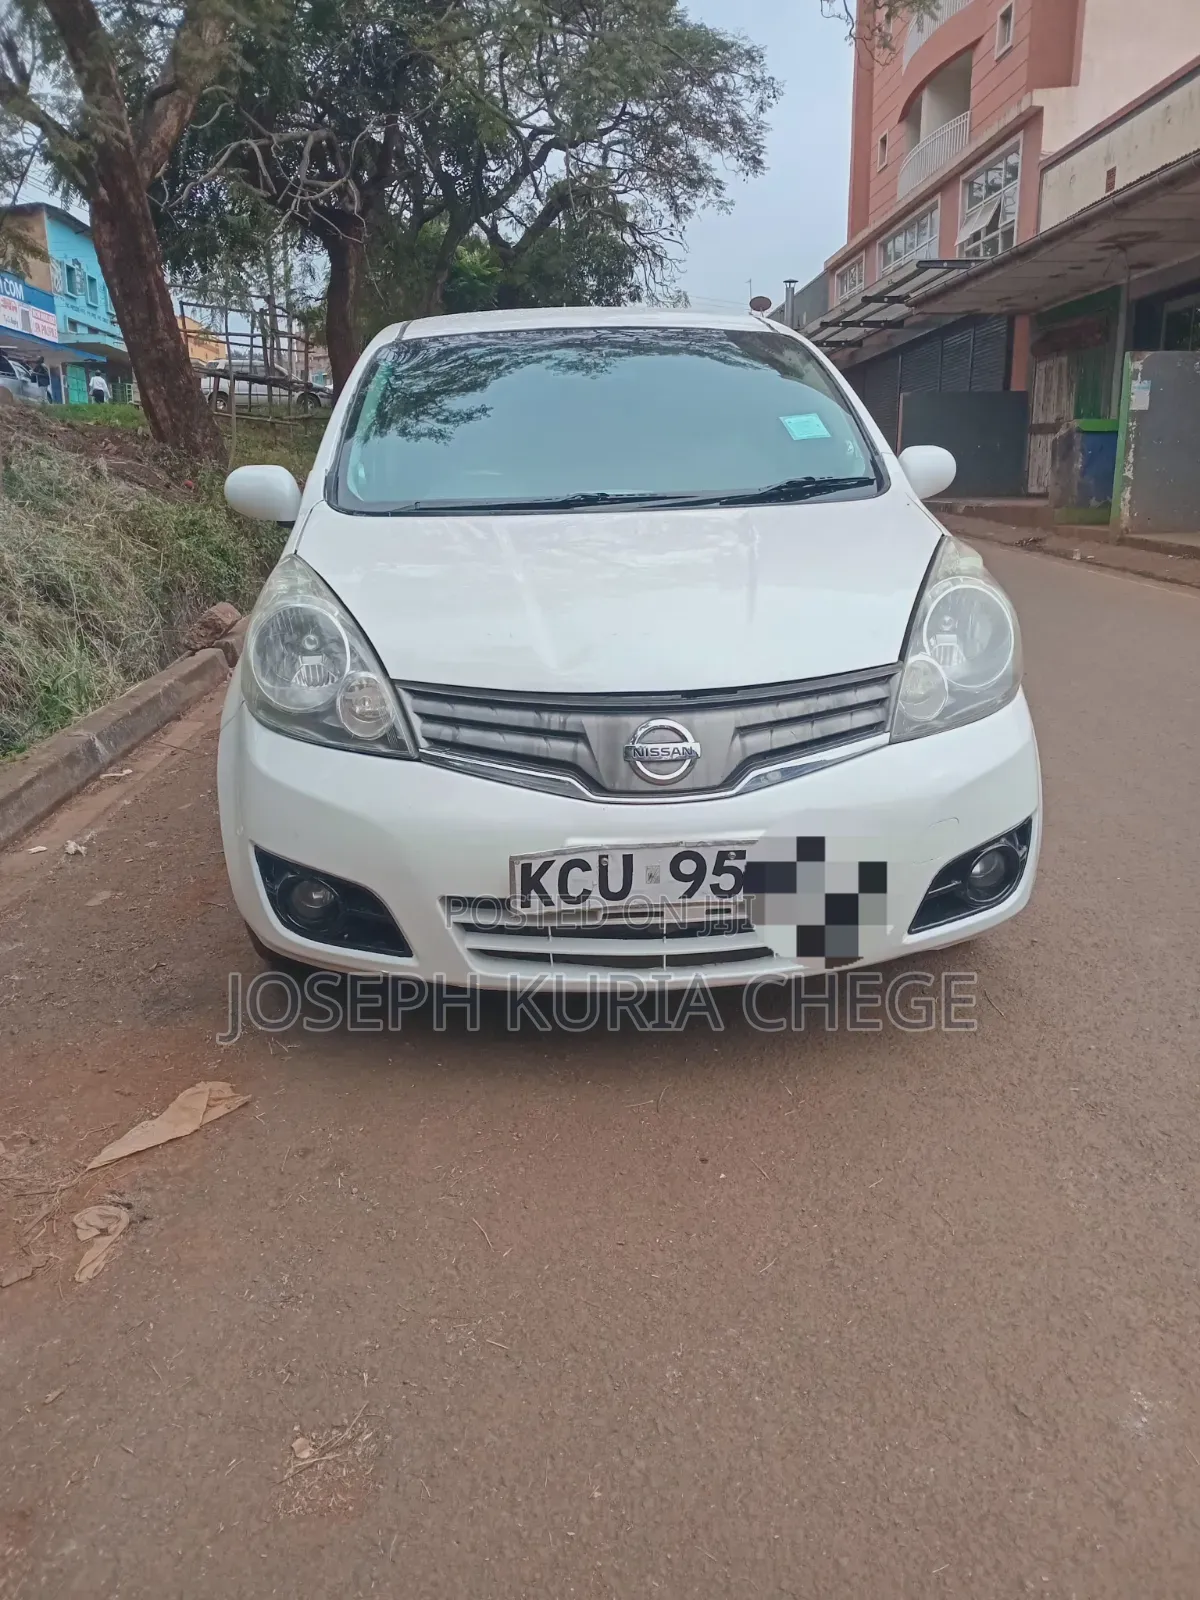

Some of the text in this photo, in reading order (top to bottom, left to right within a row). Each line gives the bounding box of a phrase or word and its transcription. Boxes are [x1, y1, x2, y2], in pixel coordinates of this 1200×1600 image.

[633, 746, 693, 758] NISSAN
[520, 849, 747, 909] KCU 95
